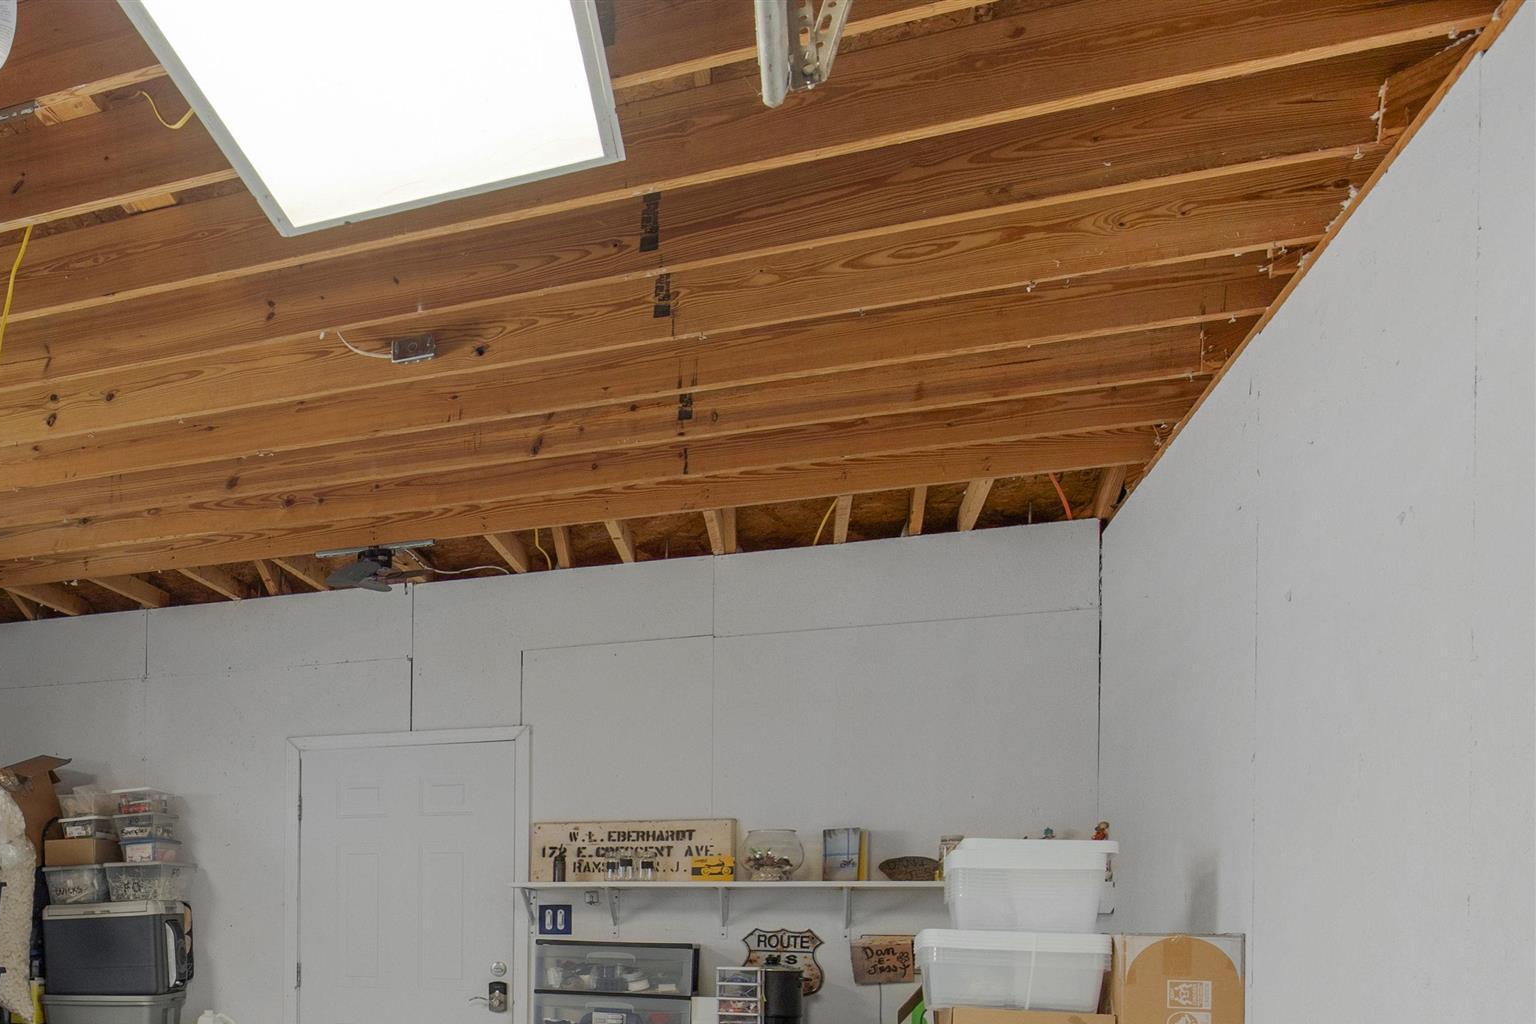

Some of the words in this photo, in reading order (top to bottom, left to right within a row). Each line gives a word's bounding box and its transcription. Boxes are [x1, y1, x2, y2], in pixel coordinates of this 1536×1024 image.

[55, 886, 82, 897] WICKS
[757, 934, 810, 950] ROUTE
[862, 946, 897, 960] Dan
